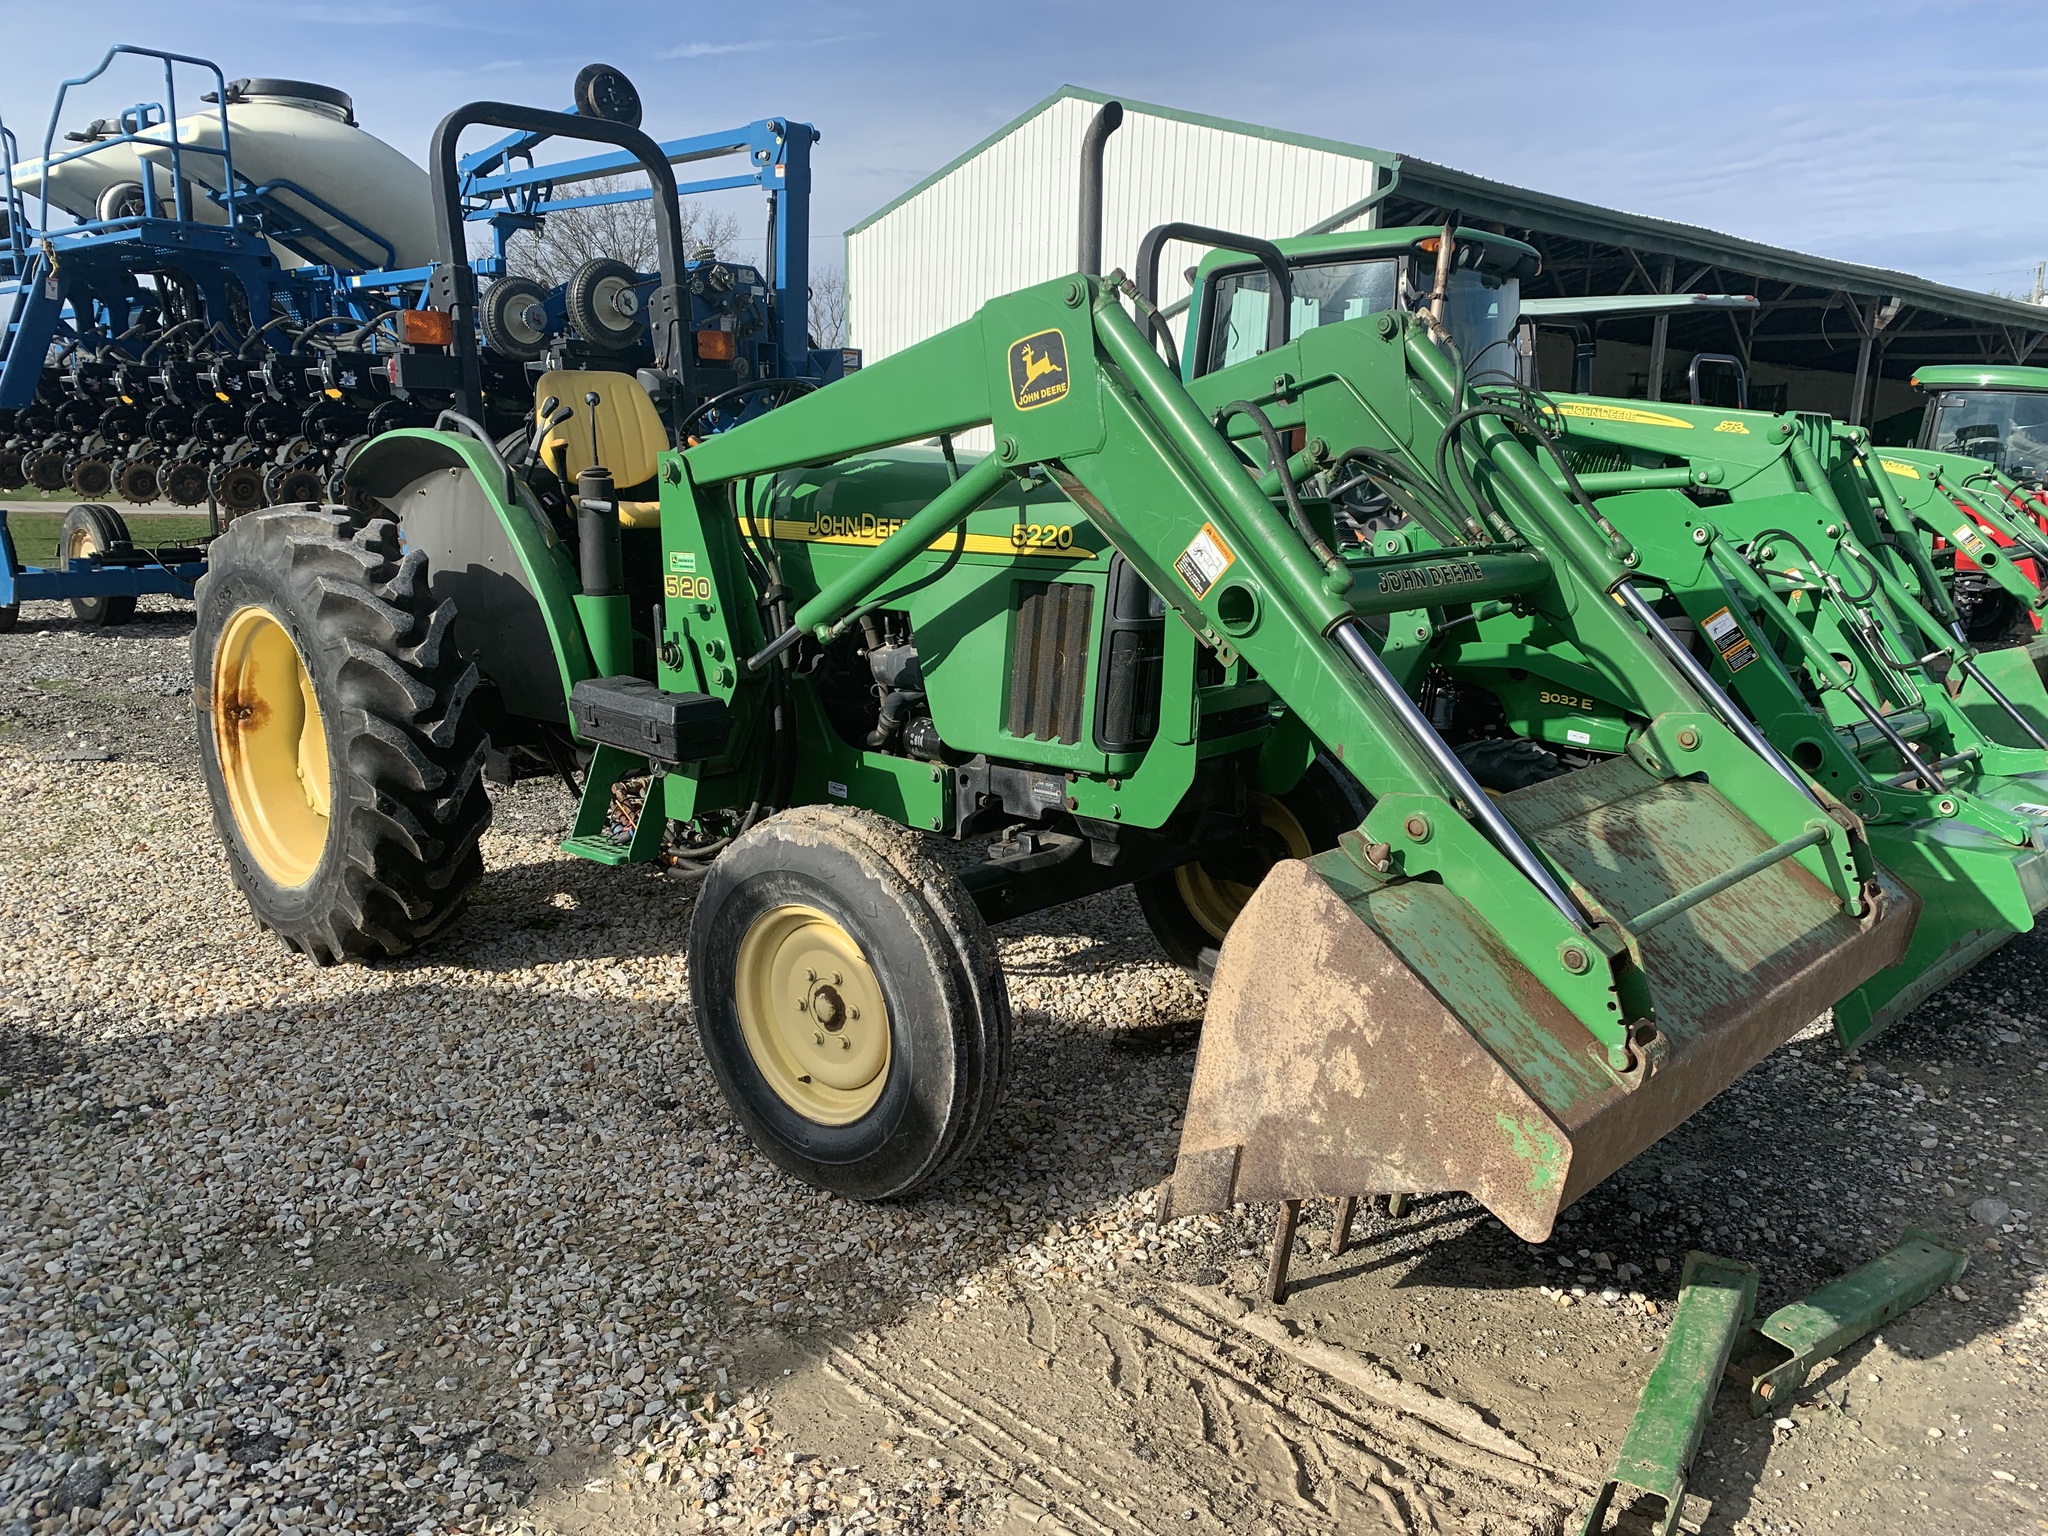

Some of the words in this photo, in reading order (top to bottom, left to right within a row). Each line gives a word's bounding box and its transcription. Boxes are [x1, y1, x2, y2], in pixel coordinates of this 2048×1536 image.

[1018, 391, 1040, 406] JOHN
[1041, 382, 1067, 399] DEERE
[1567, 404, 1599, 417] JOHN
[1600, 407, 1638, 421] DEERE
[1720, 420, 1744, 432] 673
[808, 510, 859, 538] JOHN
[860, 512, 912, 539] DEE
[1011, 523, 1074, 550] 5220
[1211, 533, 1232, 560] WARNING
[664, 574, 711, 600] 520
[1378, 568, 1428, 594] JOHN
[1426, 561, 1484, 587] DEERE
[1539, 691, 1578, 707] 3032
[1581, 698, 1594, 711] E
